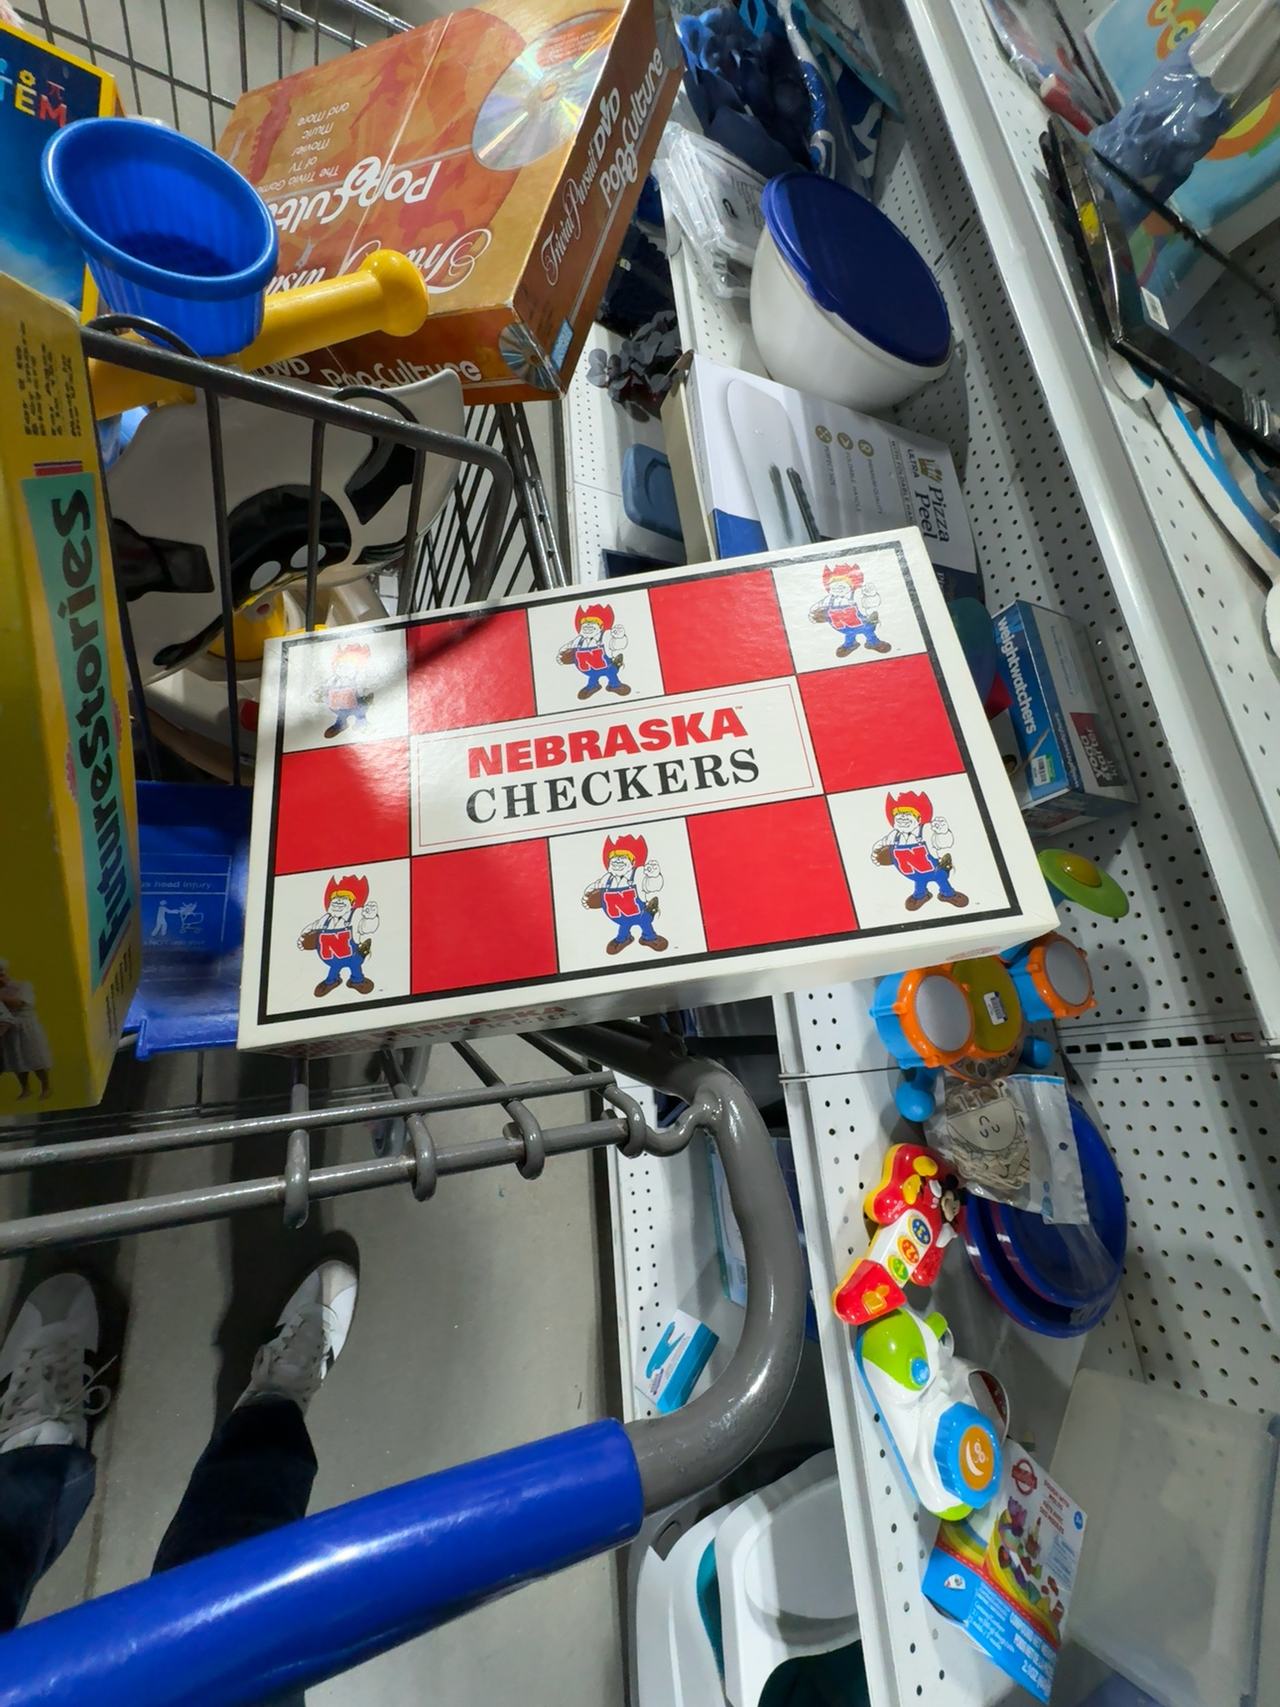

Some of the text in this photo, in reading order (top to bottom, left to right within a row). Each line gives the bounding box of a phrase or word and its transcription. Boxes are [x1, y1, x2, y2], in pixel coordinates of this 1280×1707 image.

[593, 88, 620, 161] DVD
[288, 160, 303, 173] TV
[914, 485, 950, 543] Pizza Peel
[997, 616, 1037, 735] weightwatchers
[467, 706, 748, 779] NEBRASKA
[465, 747, 760, 824] CHECKERS
